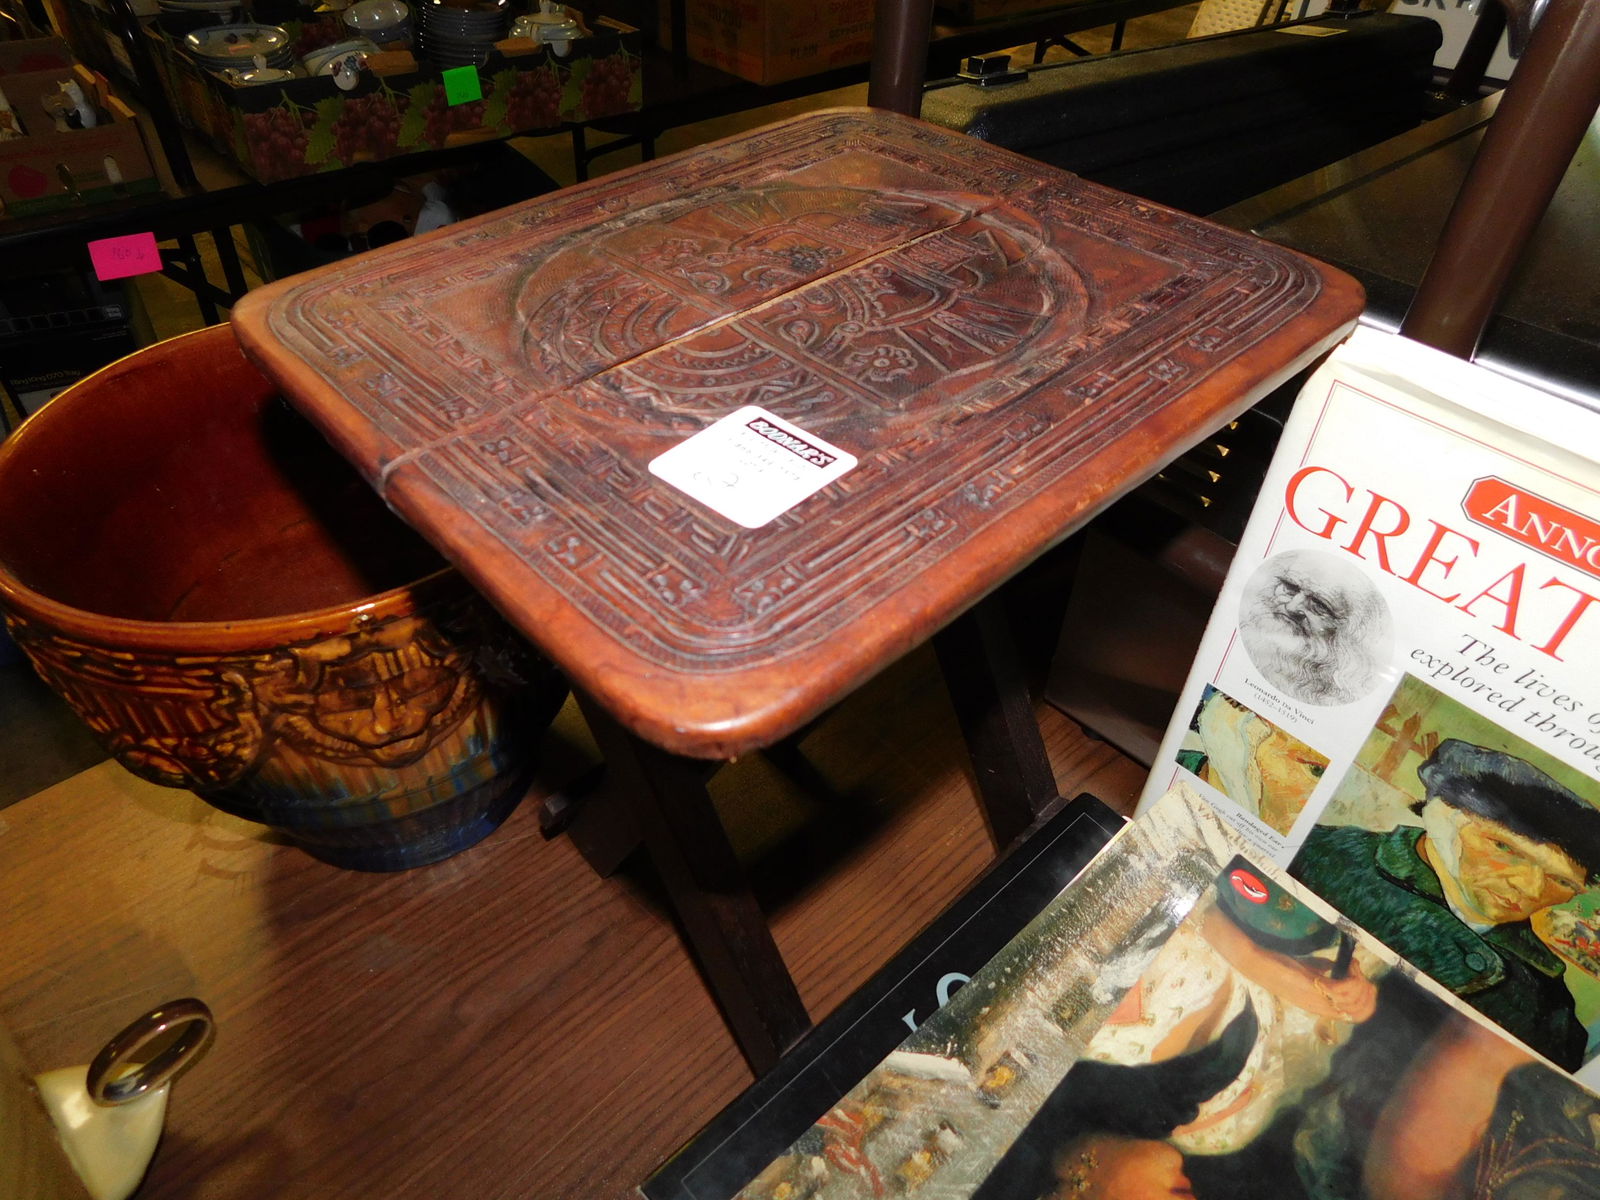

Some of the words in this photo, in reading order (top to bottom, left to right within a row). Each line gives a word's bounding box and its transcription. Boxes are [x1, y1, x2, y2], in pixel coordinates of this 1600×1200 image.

[1284, 466, 1600, 662] GREAT
[1244, 678, 1281, 703] Leonardo
[1294, 707, 1315, 725] Vinci
[1410, 648, 1526, 713] explored
[1524, 710, 1600, 775] throu
[1458, 633, 1509, 674] The
[1513, 667, 1583, 712] lives
